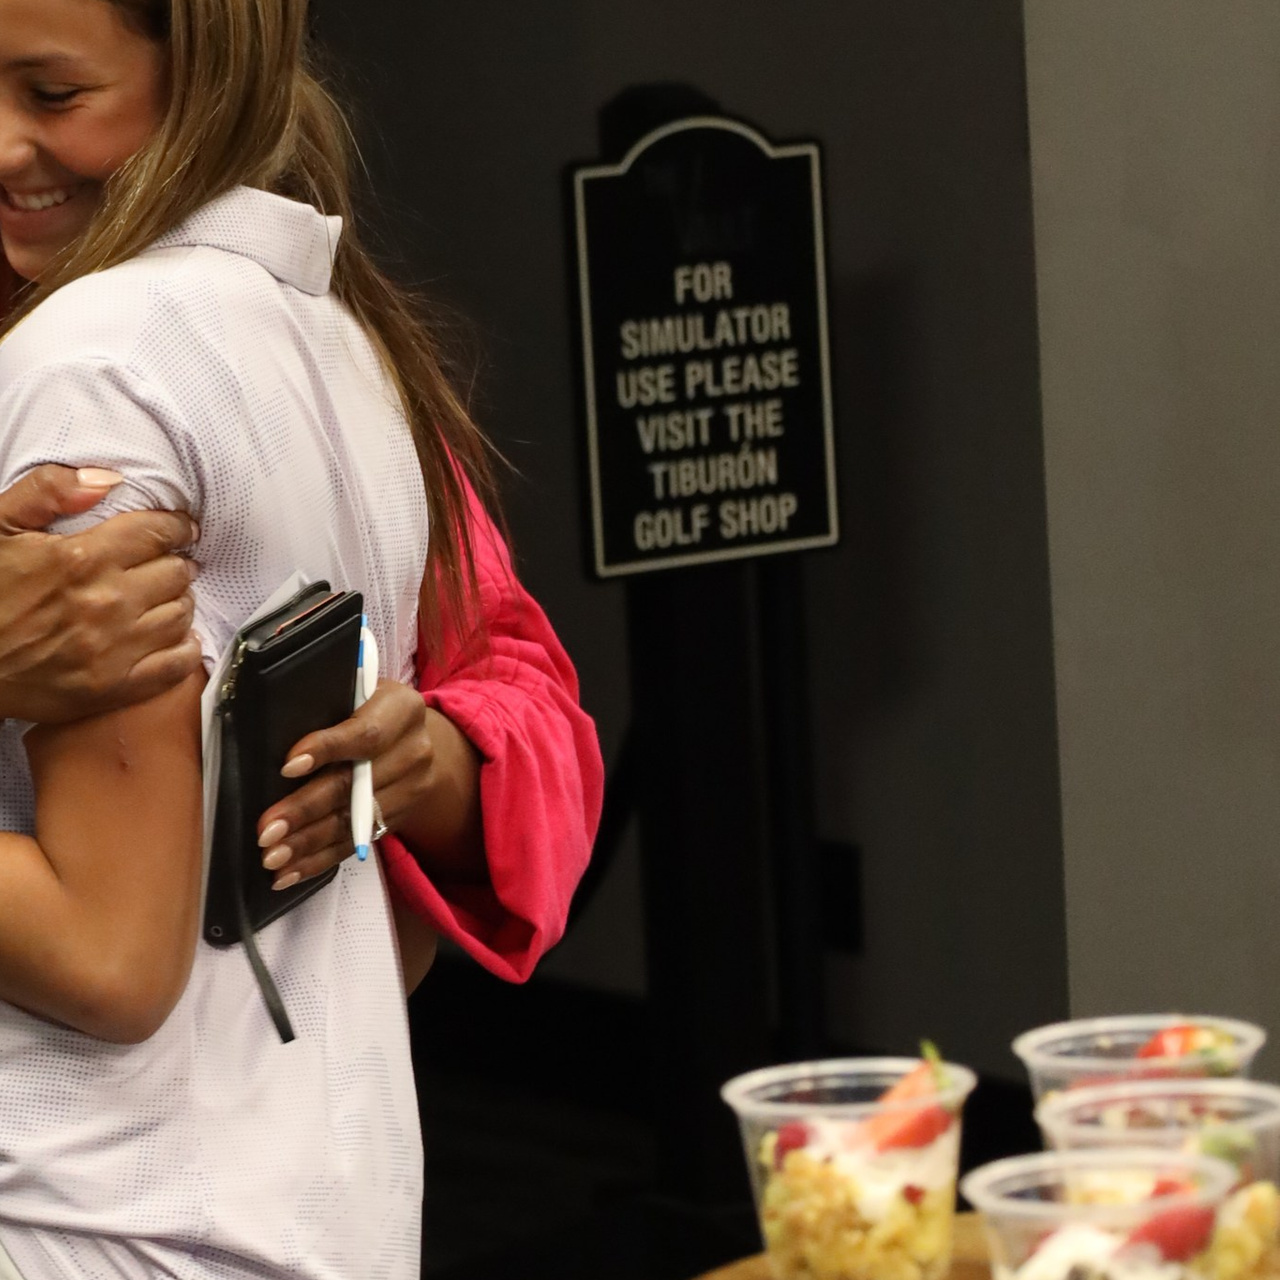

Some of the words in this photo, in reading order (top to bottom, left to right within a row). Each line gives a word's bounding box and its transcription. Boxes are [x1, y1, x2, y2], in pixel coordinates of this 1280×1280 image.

[674, 261, 732, 304] FOR
[621, 303, 790, 359] SIMULATOR
[618, 366, 675, 408] USE
[685, 348, 799, 400] PLEASE
[637, 407, 713, 453] VISIT
[724, 399, 784, 442] THE
[650, 442, 778, 499] TIBURÓN
[634, 506, 709, 550] GOLF
[720, 493, 797, 539] SHOP
